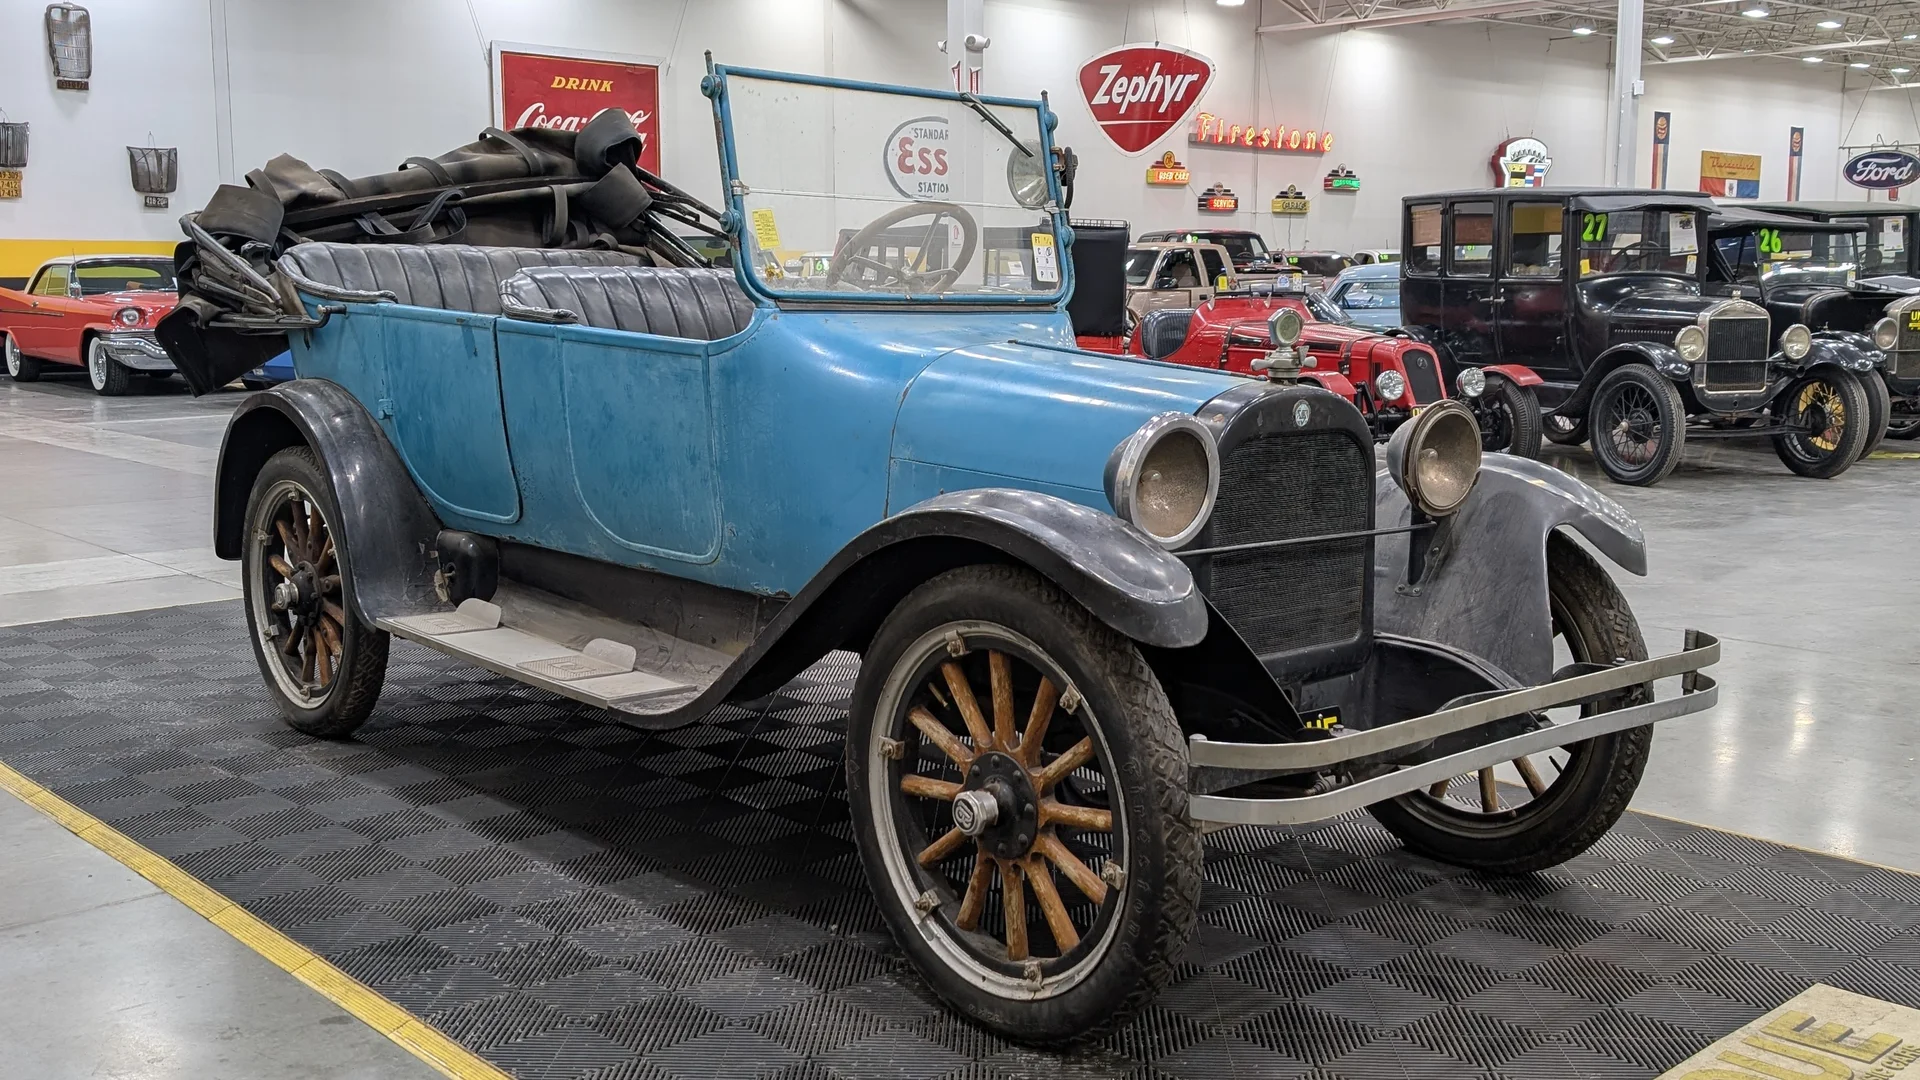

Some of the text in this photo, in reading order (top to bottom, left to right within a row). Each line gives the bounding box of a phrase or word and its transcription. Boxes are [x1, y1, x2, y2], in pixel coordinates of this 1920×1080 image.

[551, 76, 614, 92] DRINK
[1091, 62, 1199, 114] Zephyr
[1196, 112, 1335, 151] Firestone
[1852, 157, 1914, 181] Ford
[1582, 213, 1608, 242] 27
[1760, 228, 1782, 253] 26
